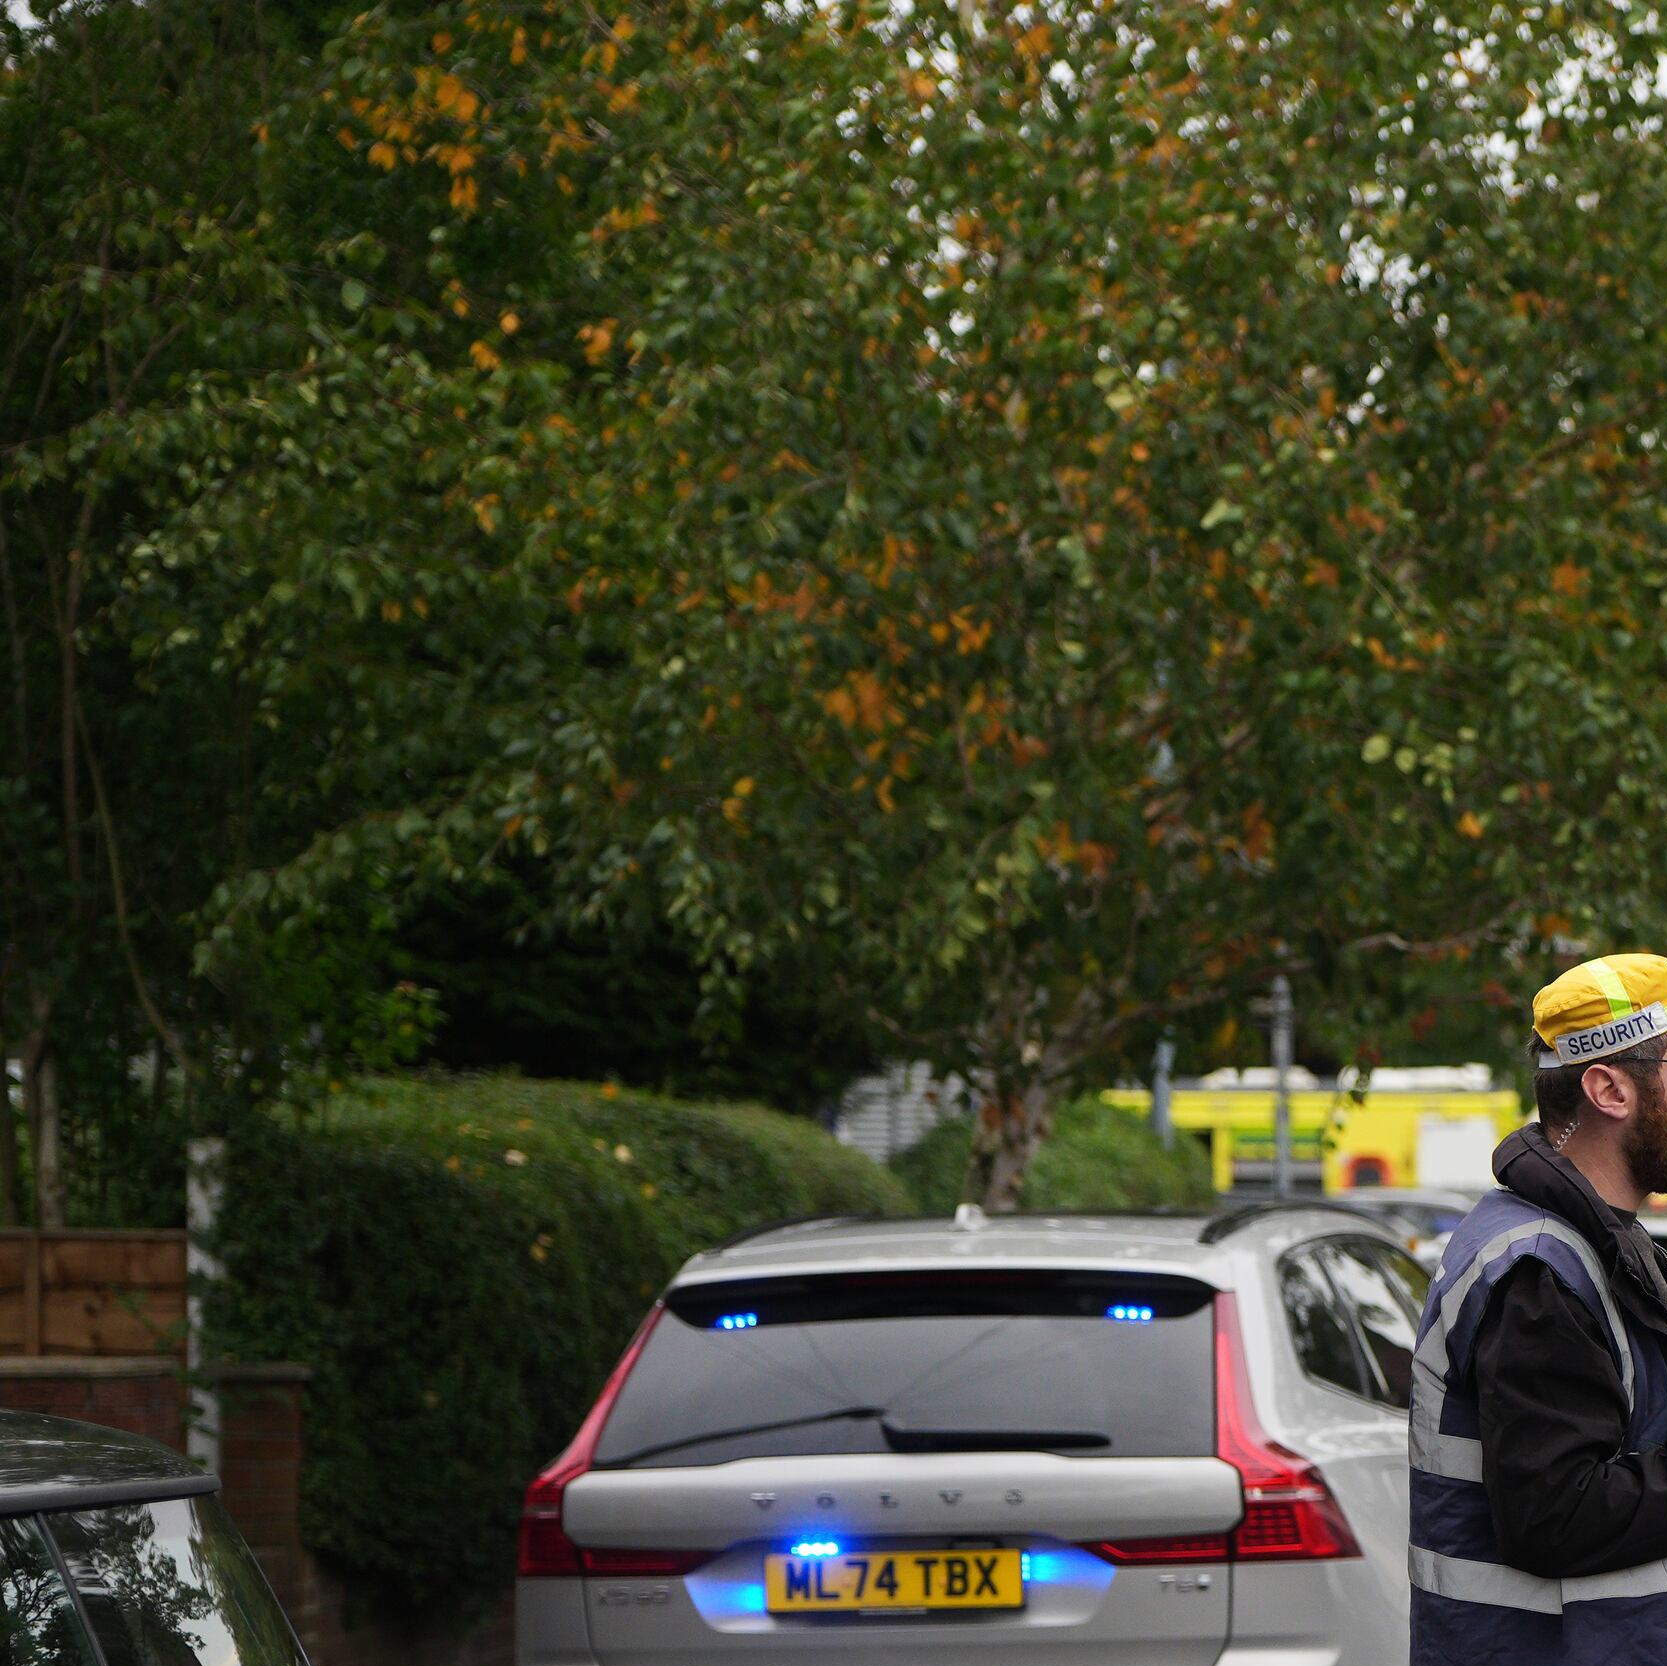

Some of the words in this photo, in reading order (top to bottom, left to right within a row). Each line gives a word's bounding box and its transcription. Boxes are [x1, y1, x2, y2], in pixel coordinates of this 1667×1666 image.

[1568, 1012, 1654, 1055] SECURITY
[751, 1489, 1024, 1510] VOLVO
[785, 1560, 897, 1600] ML74
[915, 1557, 998, 1597] TBX
